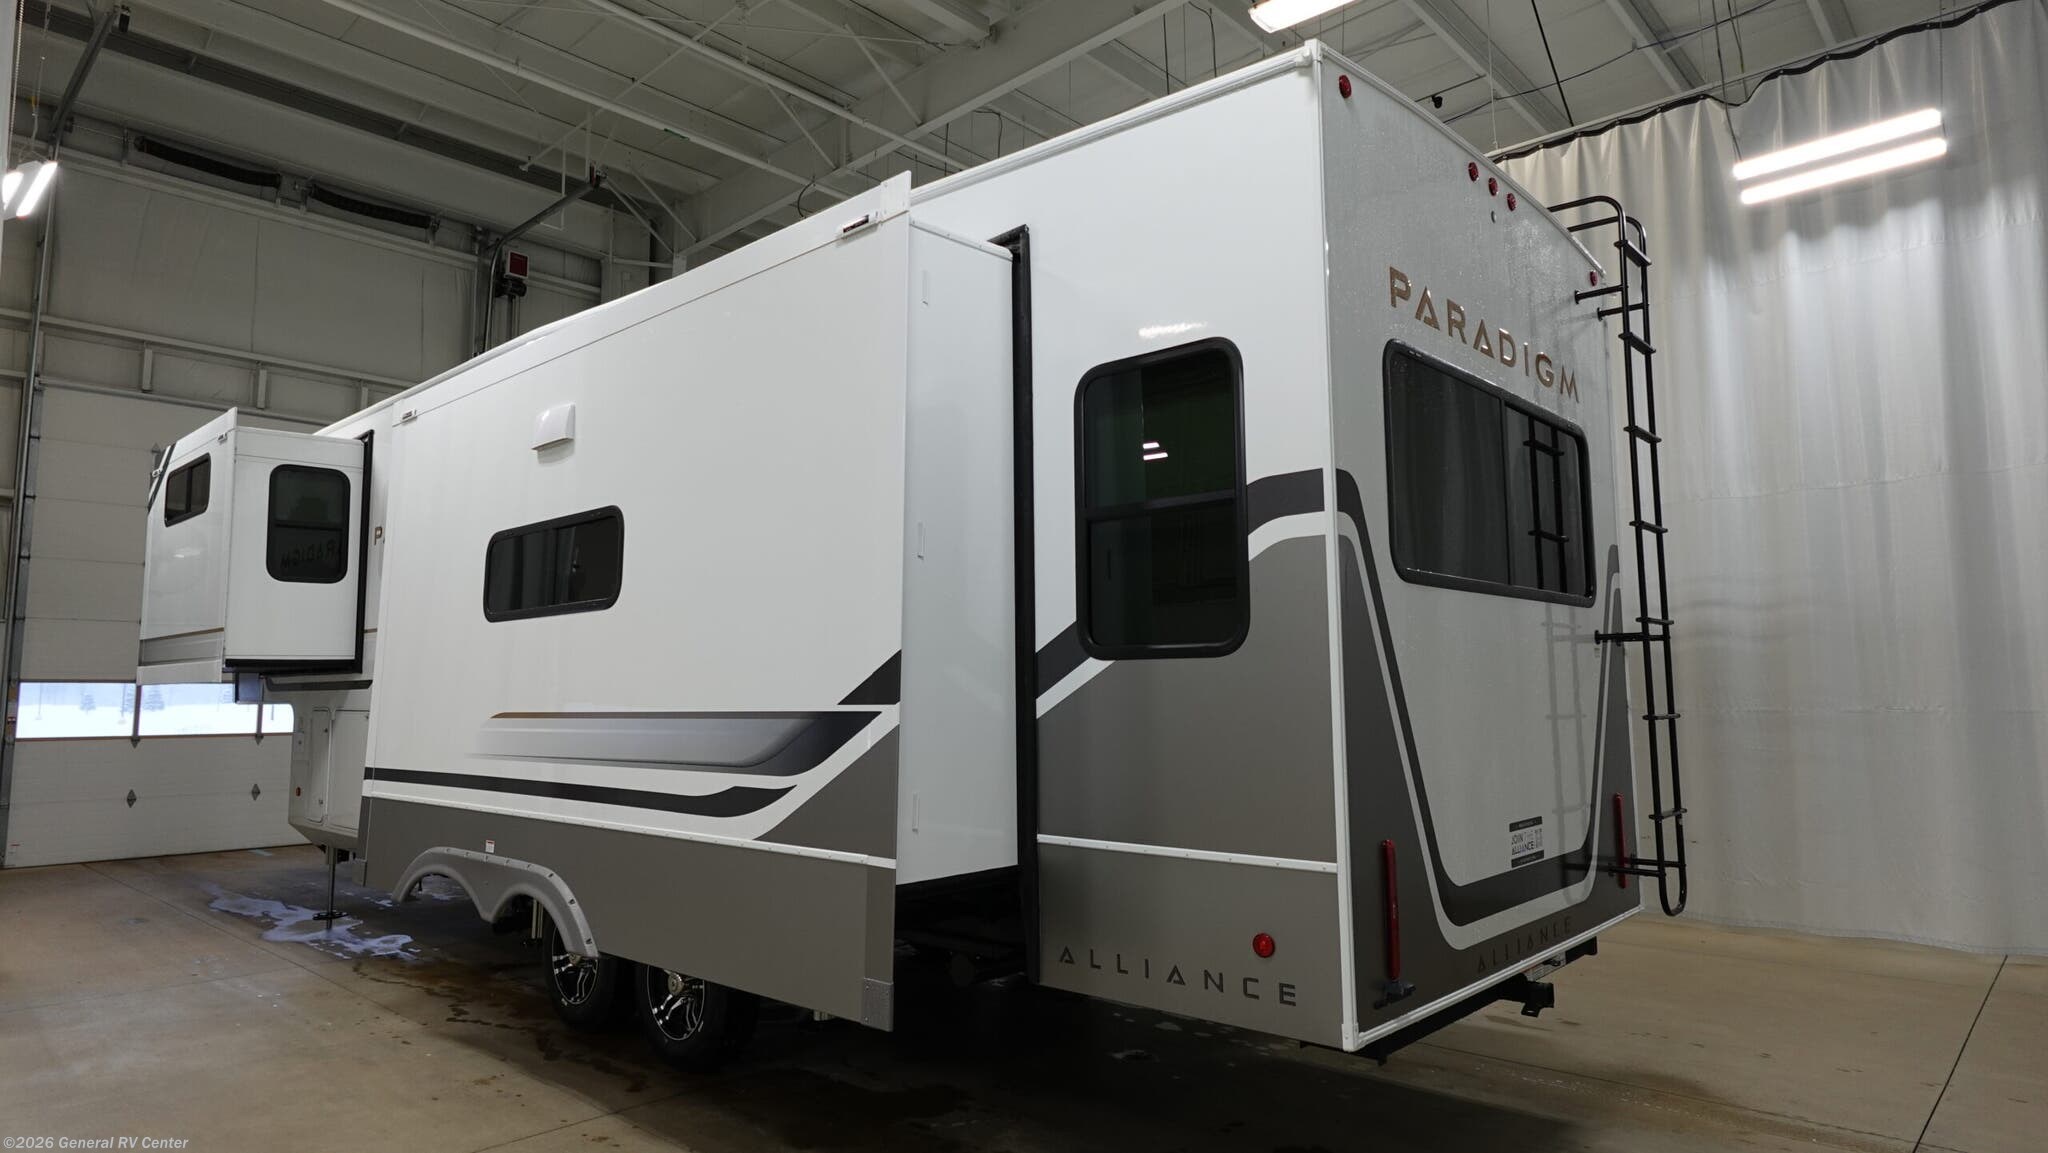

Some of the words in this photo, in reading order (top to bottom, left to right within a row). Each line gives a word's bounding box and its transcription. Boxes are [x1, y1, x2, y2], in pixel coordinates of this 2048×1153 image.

[1389, 266, 1580, 404] PARADIGM
[1511, 841, 1535, 855] ALLIANCE
[1477, 916, 1572, 974] ALLIANCE
[1059, 946, 1297, 1007] ALLIANCE
